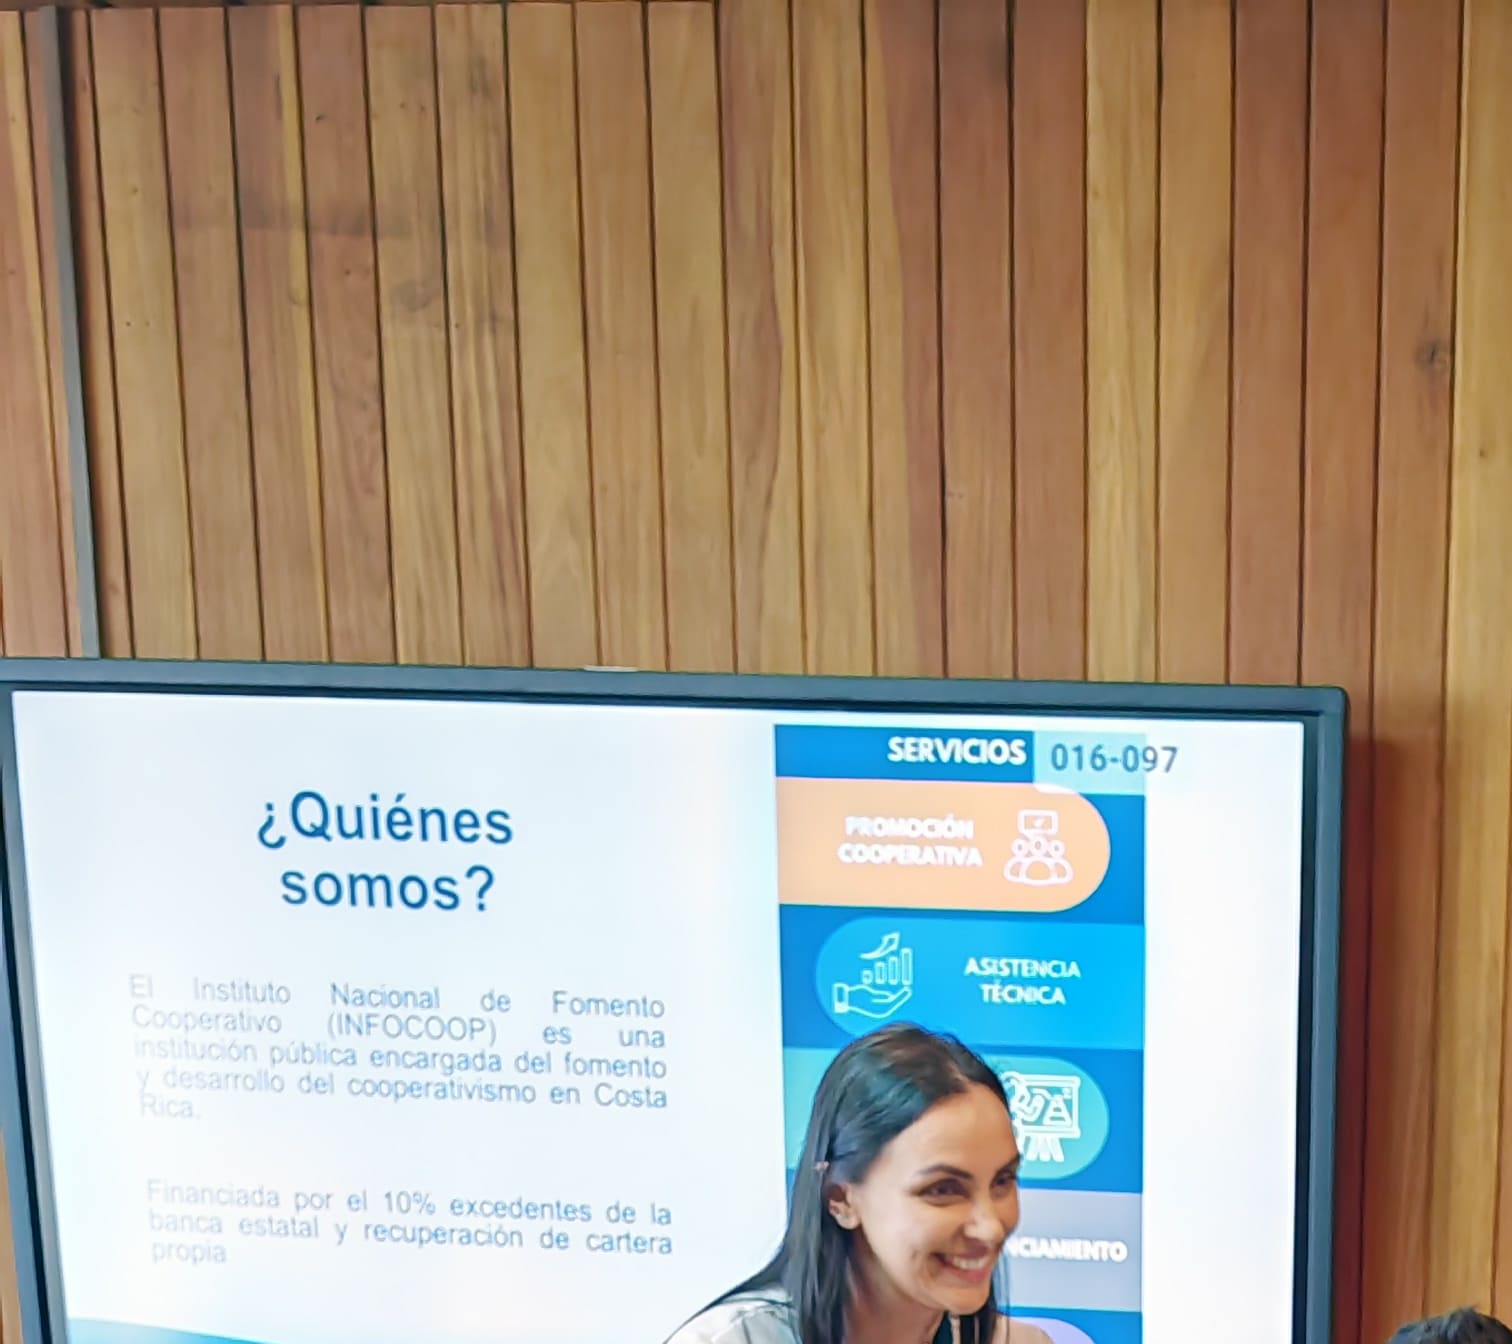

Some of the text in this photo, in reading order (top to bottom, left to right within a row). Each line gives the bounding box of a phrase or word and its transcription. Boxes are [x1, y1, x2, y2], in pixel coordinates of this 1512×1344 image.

[887, 735, 1028, 767] SERVICIOS
[1050, 742, 1180, 775] 016-097
[257, 790, 514, 850] ¿Quiénes
[844, 813, 976, 841] PROMOCIÓN
[836, 841, 984, 868] COOPERATIVA
[280, 863, 496, 912] somos?
[964, 956, 1083, 980] ASISTENCIA
[129, 973, 665, 1018] El Instituto Nacional de Fomento
[979, 979, 1068, 1006] TÉCNICA
[132, 1003, 666, 1049] Cooperativo (INFOCOOP) es una
[134, 1033, 667, 1079] institución pública encargada del fomento
[137, 1066, 668, 1108] y desarrollo del cooperativismo en Costa
[148, 1178, 672, 1227] Financiada por el 10% excedentes de la
[150, 1207, 673, 1256] banca estatal y recuperación de cartera
[1006, 1235, 1129, 1263] NCIAMIENTO
[151, 1240, 228, 1267] propia
